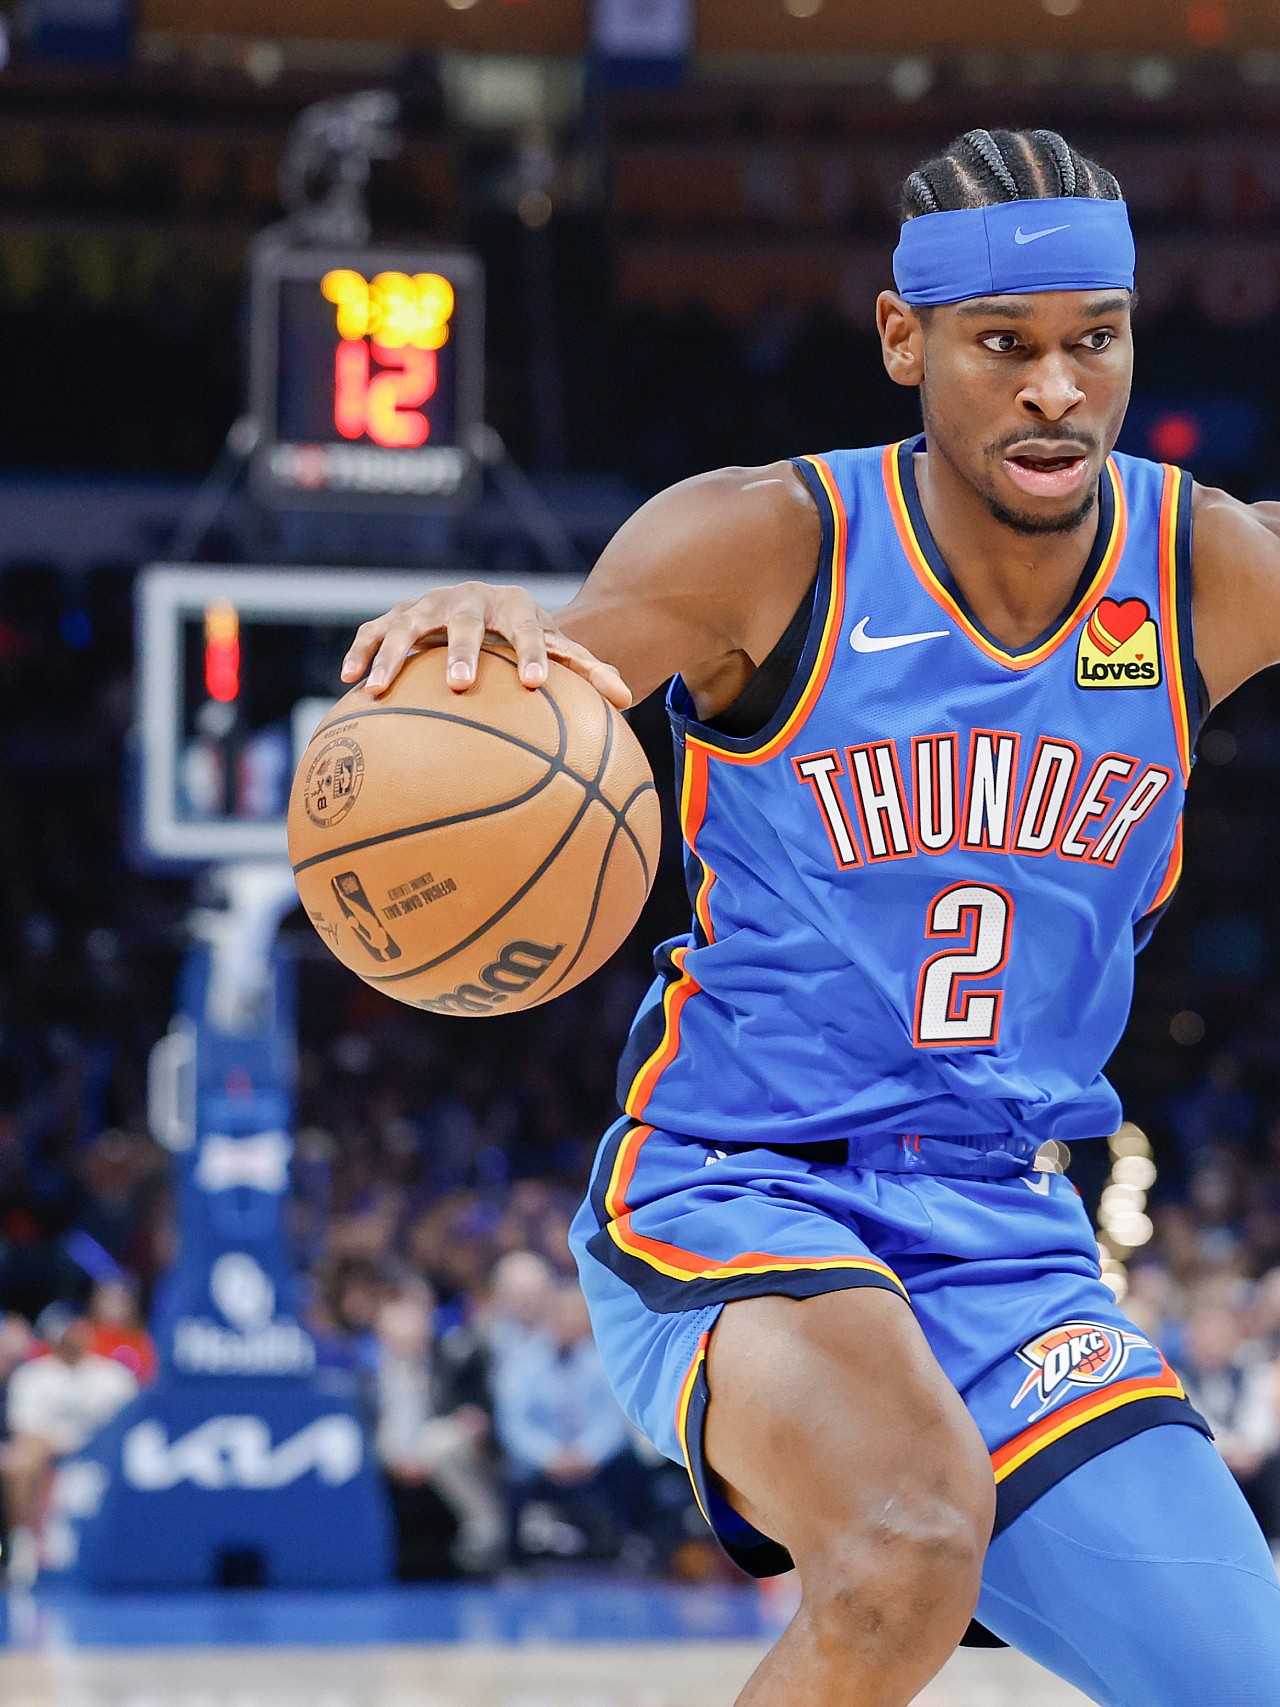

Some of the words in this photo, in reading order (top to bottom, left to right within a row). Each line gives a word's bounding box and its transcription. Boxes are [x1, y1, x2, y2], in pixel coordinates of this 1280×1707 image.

[791, 728, 1172, 871] THUNDER
[912, 880, 1015, 1048] 2
[1041, 1330, 1105, 1396] OKC
